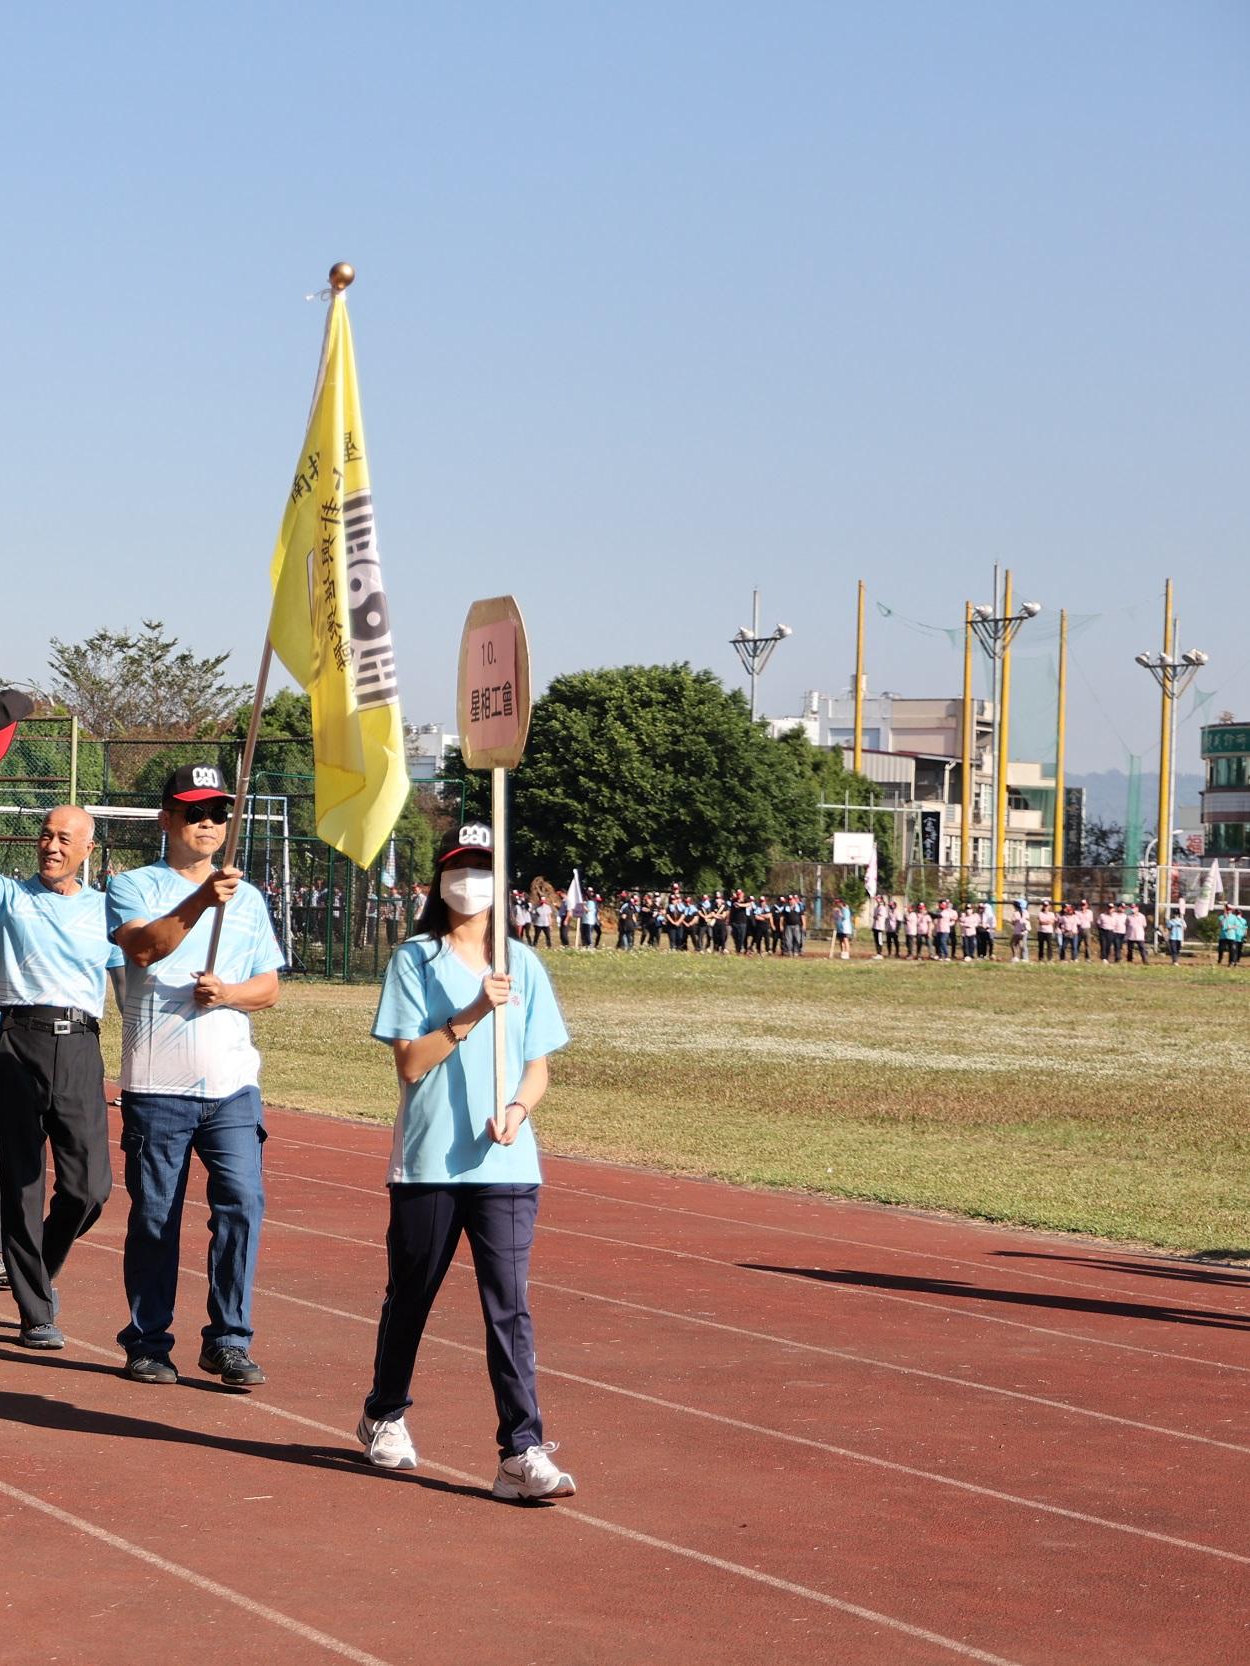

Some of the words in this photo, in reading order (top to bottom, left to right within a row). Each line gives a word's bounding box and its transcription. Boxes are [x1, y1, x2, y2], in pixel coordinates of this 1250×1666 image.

[481, 641, 497, 667] 10.
[470, 680, 513, 723] 星相工會
